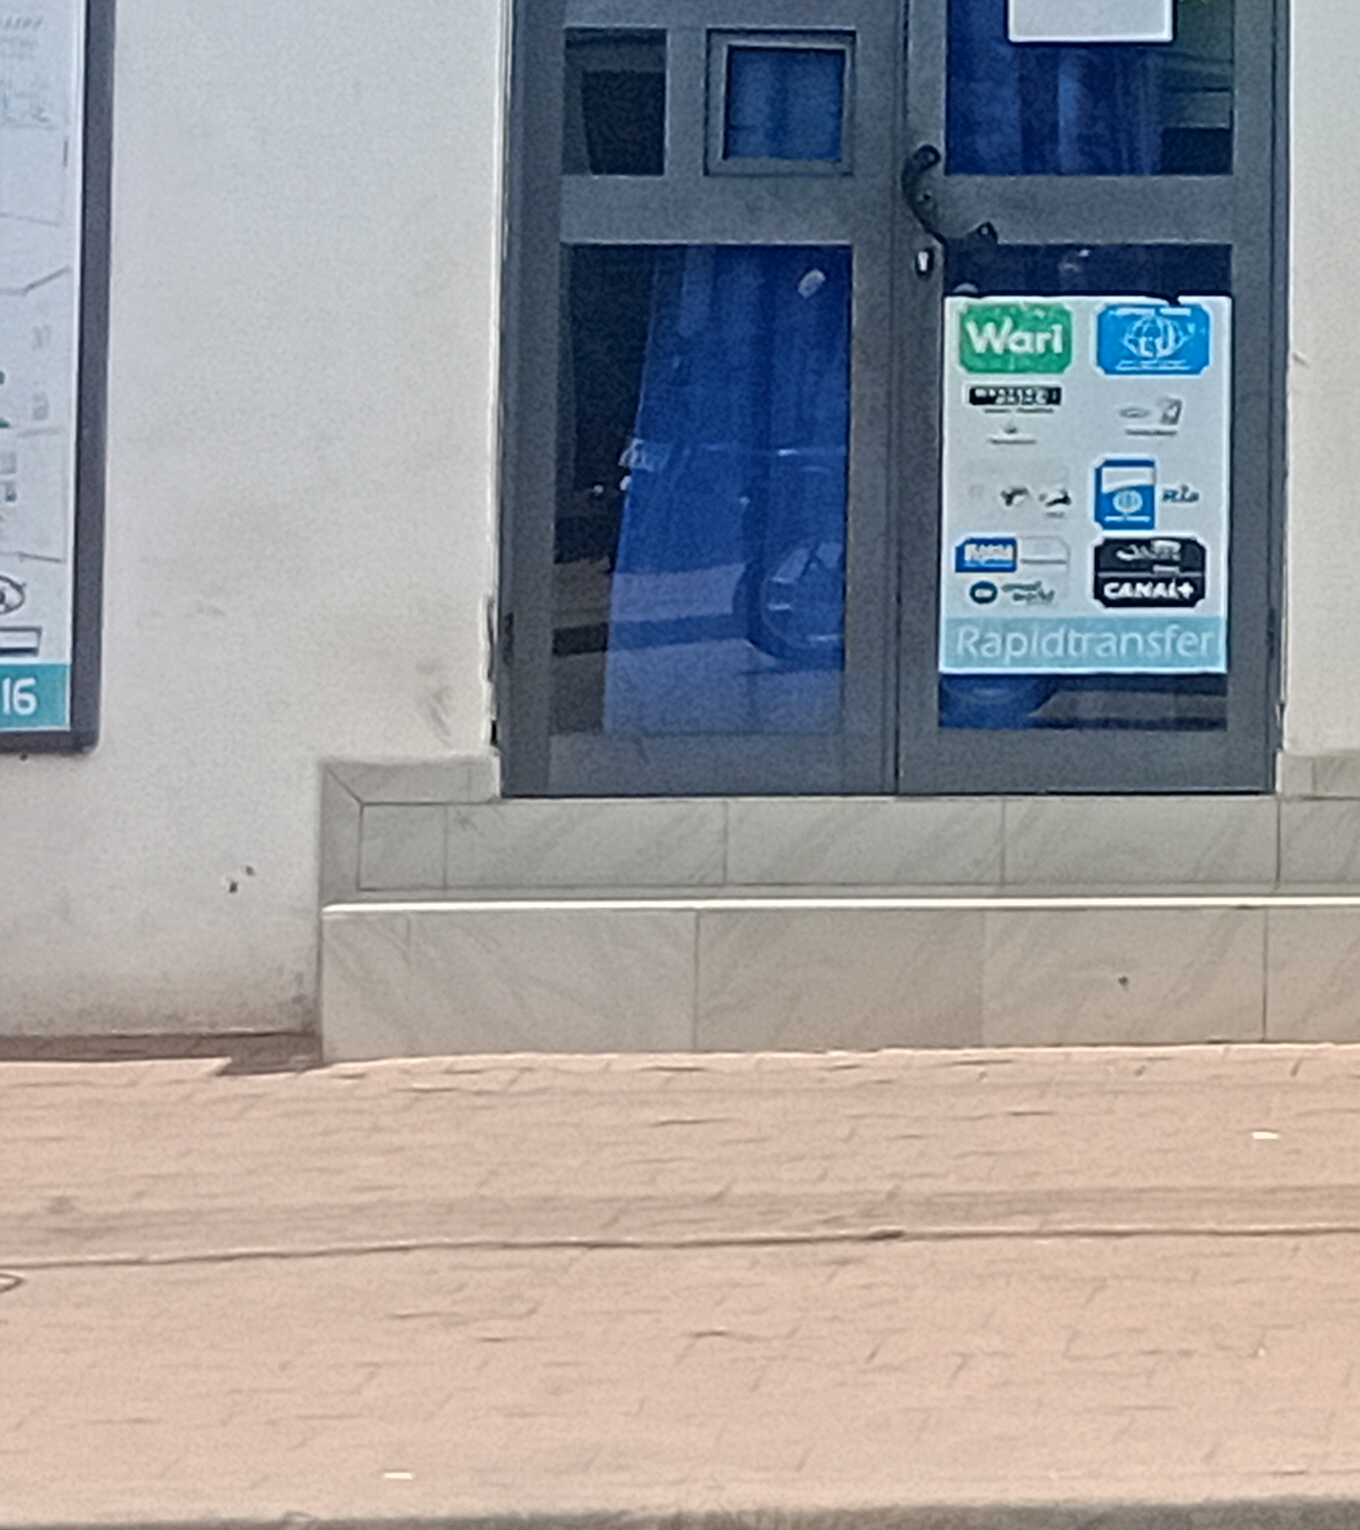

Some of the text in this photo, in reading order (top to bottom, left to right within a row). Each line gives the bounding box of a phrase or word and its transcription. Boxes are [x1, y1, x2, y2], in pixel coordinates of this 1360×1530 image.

[964, 317, 1064, 356] Wari
[1103, 579, 1195, 601] CANAL+
[955, 623, 1212, 669] Rapidtransfer
